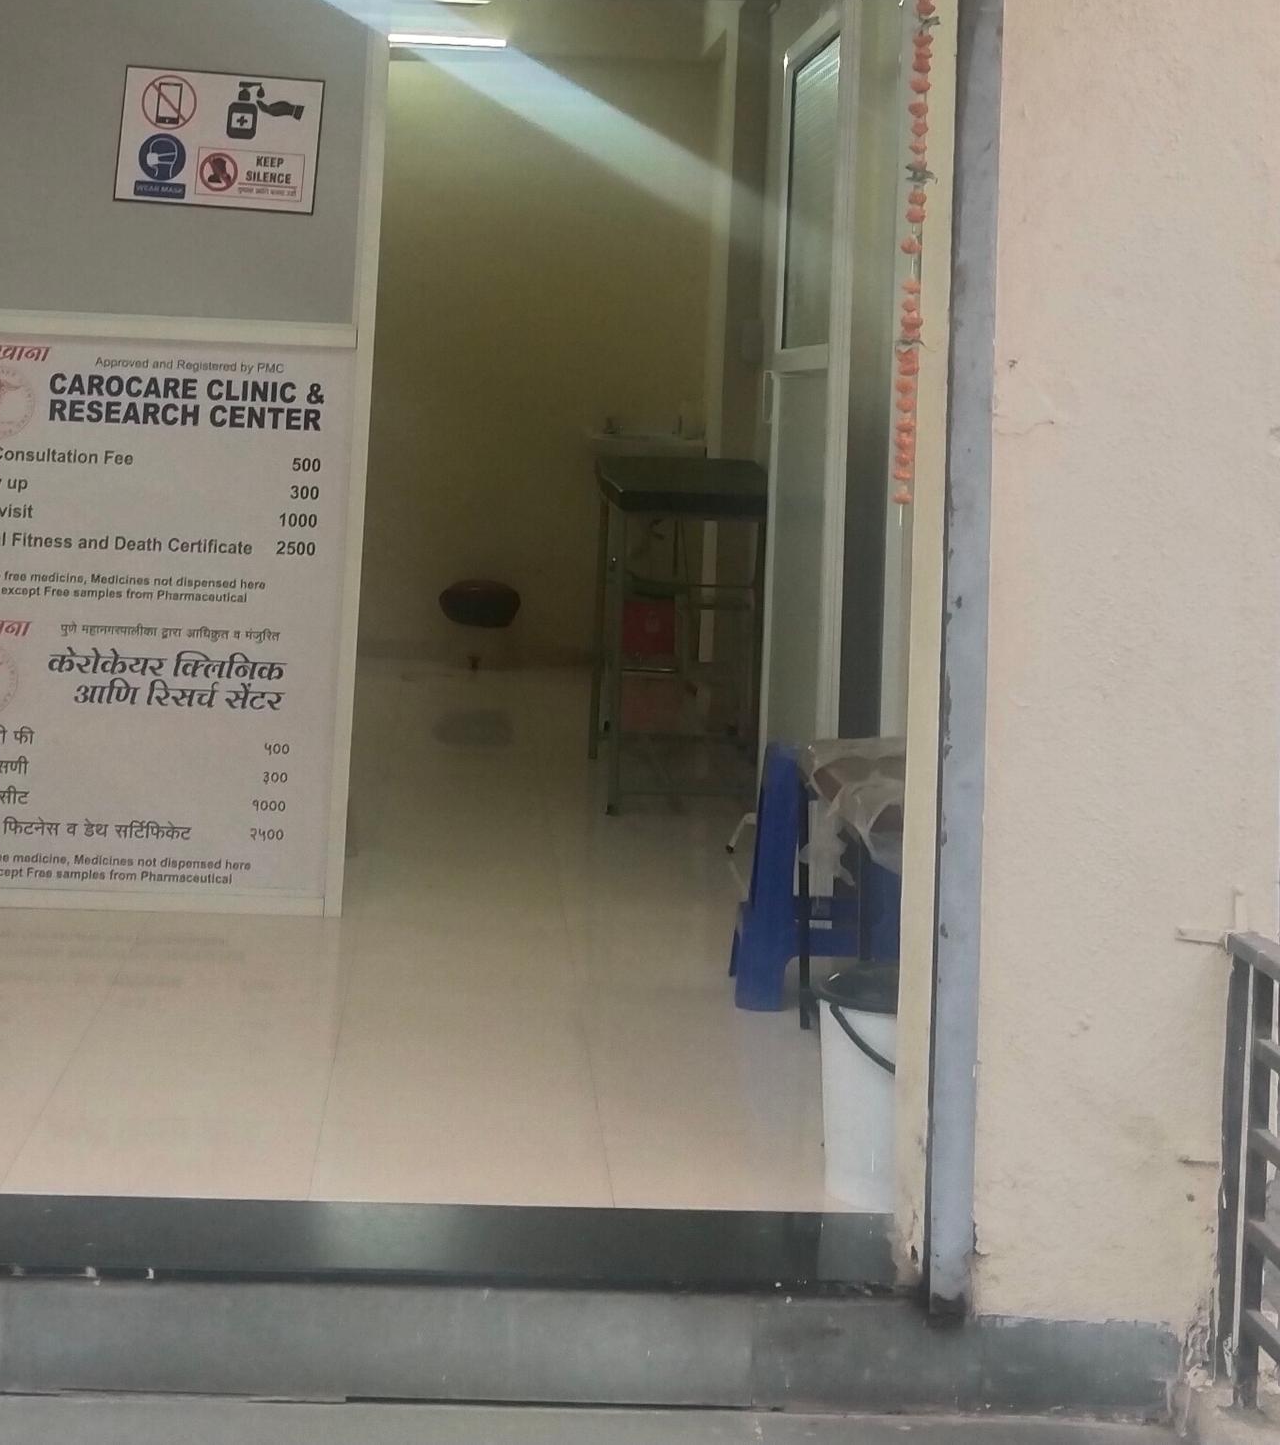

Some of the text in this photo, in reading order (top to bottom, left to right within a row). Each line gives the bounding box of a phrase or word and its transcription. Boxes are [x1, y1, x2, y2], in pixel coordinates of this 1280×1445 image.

[256, 156, 284, 168] KEEP
[246, 170, 291, 184] SILENCE
[95, 356, 284, 374] Approved and Registered by PMC
[49, 372, 325, 404] CAROCARE CLINIC &
[49, 399, 321, 431] RESEARCH CENTER
[104, 451, 134, 465] Fee
[291, 458, 321, 472] 500
[8, 476, 28, 492] up
[290, 485, 320, 500] 300
[278, 513, 318, 528] 1000
[12, 533, 73, 549] Fitness
[78, 536, 109, 550] and
[115, 536, 162, 553] Death
[168, 538, 253, 555] Certificate
[276, 541, 316, 556] 2500
[4, 571, 27, 582] free
[30, 572, 86, 585] medicine,
[91, 574, 149, 586] Medicines
[153, 575, 172, 586] not
[176, 576, 236, 589] dispensed
[240, 579, 265, 590] here
[1, 586, 247, 603] except Free samples from Pharmaceutical
[48, 647, 287, 681] केरोकेयर क्लिनिक
[74, 677, 286, 711] आणि रिसर्च सेंटर
[14, 726, 34, 745] फी
[262, 771, 288, 784] ३००
[3, 816, 58, 837] फिटनेस
[67, 823, 76, 836] व
[84, 820, 107, 838] डेथ
